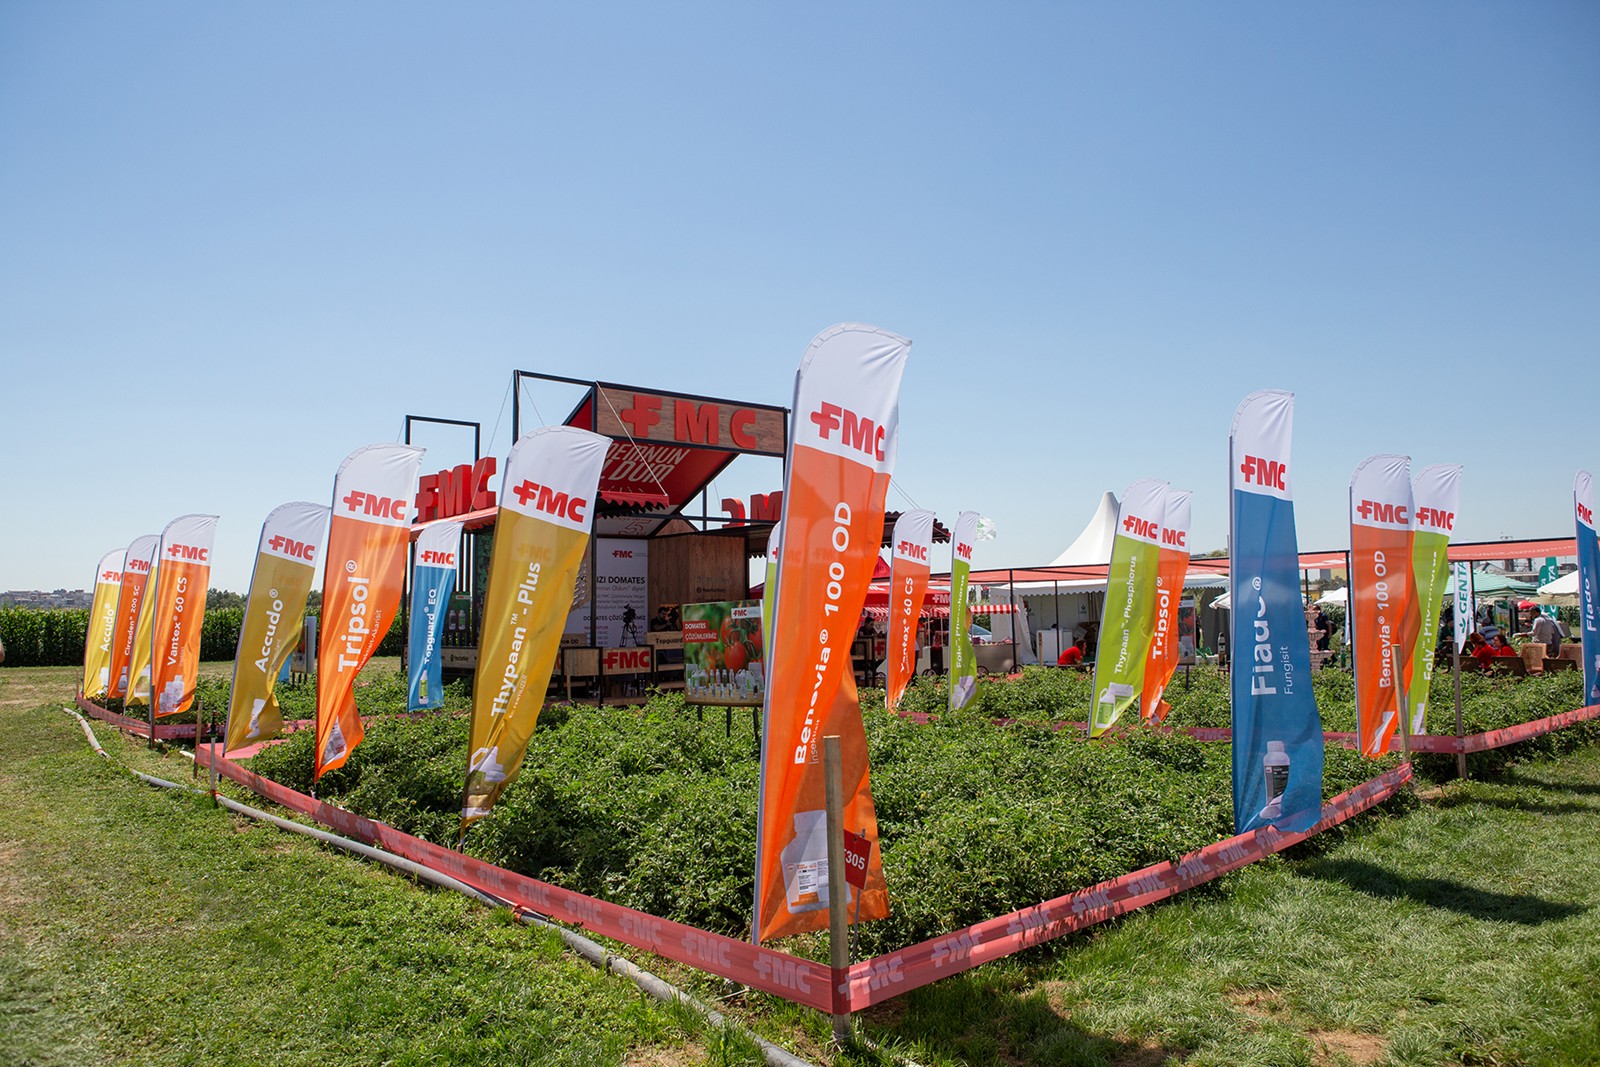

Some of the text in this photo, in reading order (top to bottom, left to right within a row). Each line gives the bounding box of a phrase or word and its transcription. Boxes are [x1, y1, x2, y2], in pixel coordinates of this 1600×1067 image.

[620, 395, 756, 449] FMC
[810, 400, 885, 462] FMC
[1240, 455, 1286, 491] FMC
[414, 457, 496, 523] FMC
[513, 479, 587, 524] FMC
[343, 490, 406, 520] FMC
[1357, 500, 1409, 524] FMC
[1416, 507, 1454, 530] FMC
[1578, 502, 1592, 525] FMC
[832, 502, 852, 552] OD
[1123, 515, 1158, 540] FMC
[1162, 528, 1186, 546] MC
[167, 544, 208, 561] FMC
[268, 534, 316, 561] FMC
[421, 550, 454, 565] FMC
[612, 550, 633, 558] FMC
[898, 541, 927, 560] FMC
[957, 542, 972, 560] FMC
[102, 570, 123, 582] FM
[129, 559, 150, 572] FM
[1374, 551, 1386, 577] OD
[133, 586, 140, 596] SC
[176, 577, 188, 594] CS
[518, 562, 541, 606] Plus
[608, 576, 646, 584] DOMATES
[825, 562, 845, 616] 100
[904, 577, 914, 594] CS
[1124, 556, 1136, 618] Phosphorus
[175, 597, 184, 612] 60
[428, 588, 437, 604] EQ
[904, 598, 912, 616] 60
[1376, 582, 1389, 610] 100
[255, 588, 284, 673] Accudo®
[685, 622, 706, 630] DOMATES
[603, 651, 650, 670] FMC
[1280, 646, 1294, 694] Fungisit
[477, 865, 505, 892] FMC
[1127, 870, 1166, 898] FMC
[517, 878, 550, 908] FMC
[564, 894, 602, 926] FMC
[619, 911, 662, 946] FMC
[681, 931, 731, 969] FMC
[931, 928, 986, 968] FMC
[754, 952, 811, 995] FMC
[838, 955, 904, 1000] FMC
